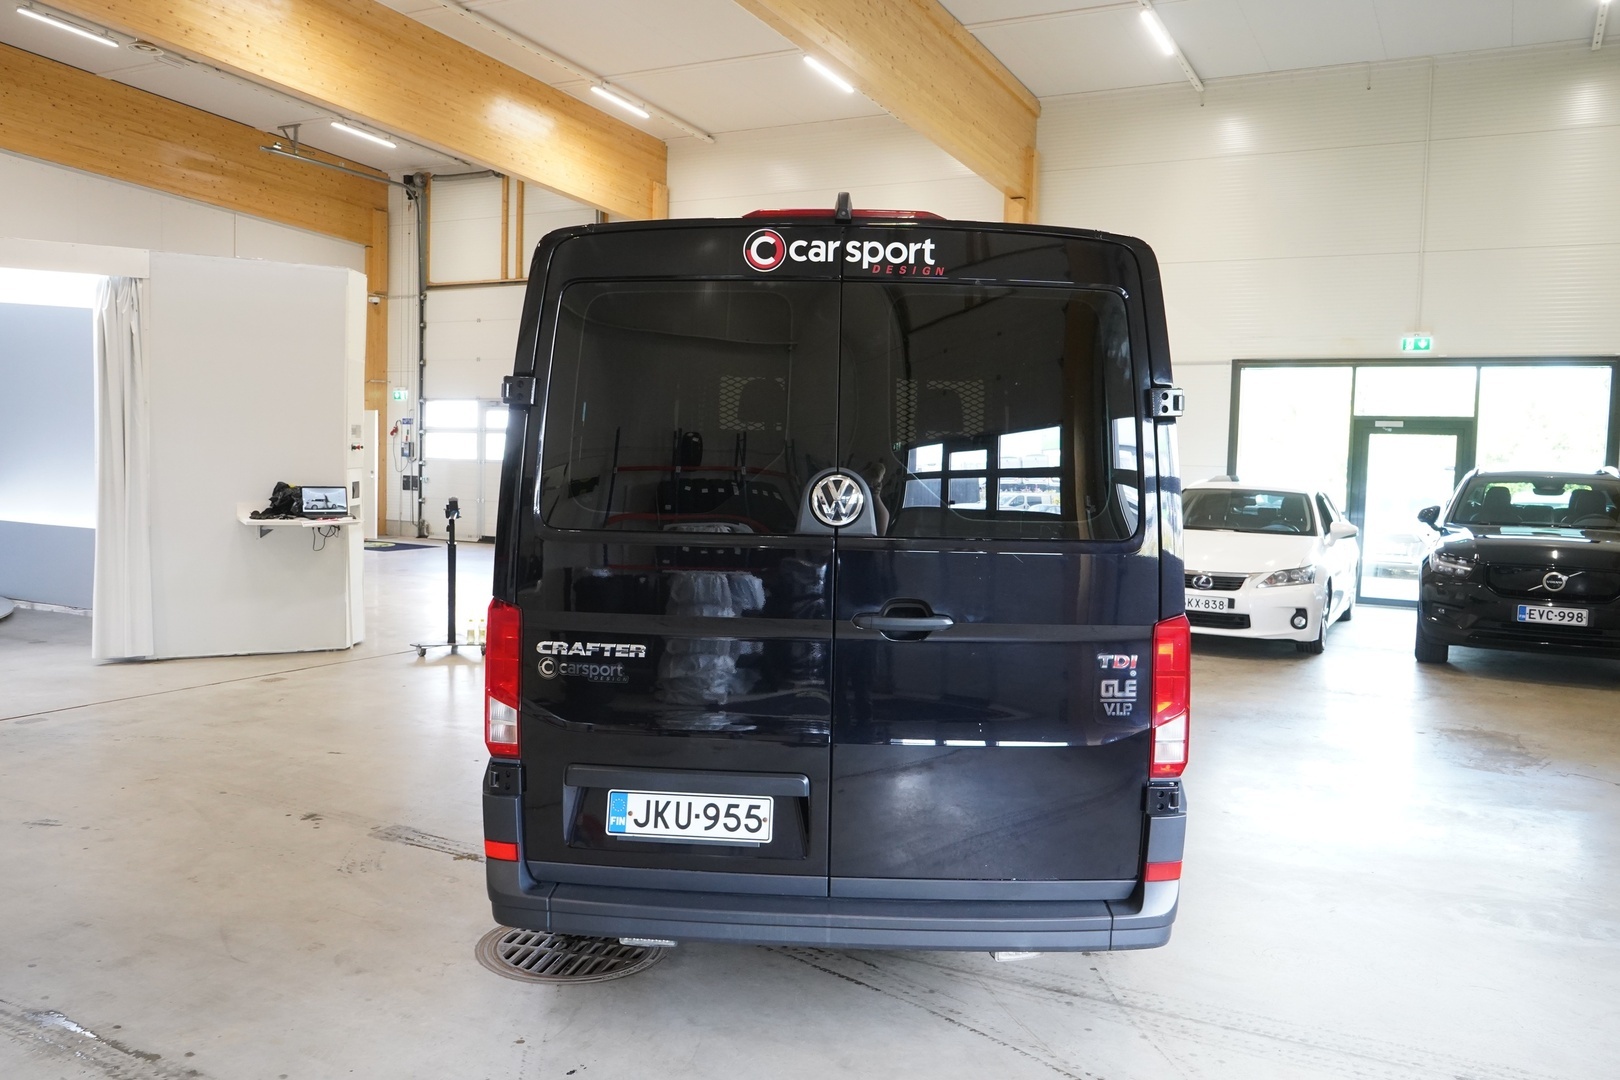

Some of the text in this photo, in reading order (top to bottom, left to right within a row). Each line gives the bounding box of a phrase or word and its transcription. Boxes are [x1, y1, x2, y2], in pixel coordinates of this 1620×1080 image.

[872, 264, 945, 277] DESIGN
[1184, 597, 1225, 611] KX-838
[1528, 608, 1584, 624] EVC-998
[535, 640, 647, 658] CRAFTER
[1097, 654, 1138, 669] TDI
[559, 662, 624, 677] carsport
[1101, 679, 1137, 698] GLE
[610, 799, 763, 833] FIN JKU-955
